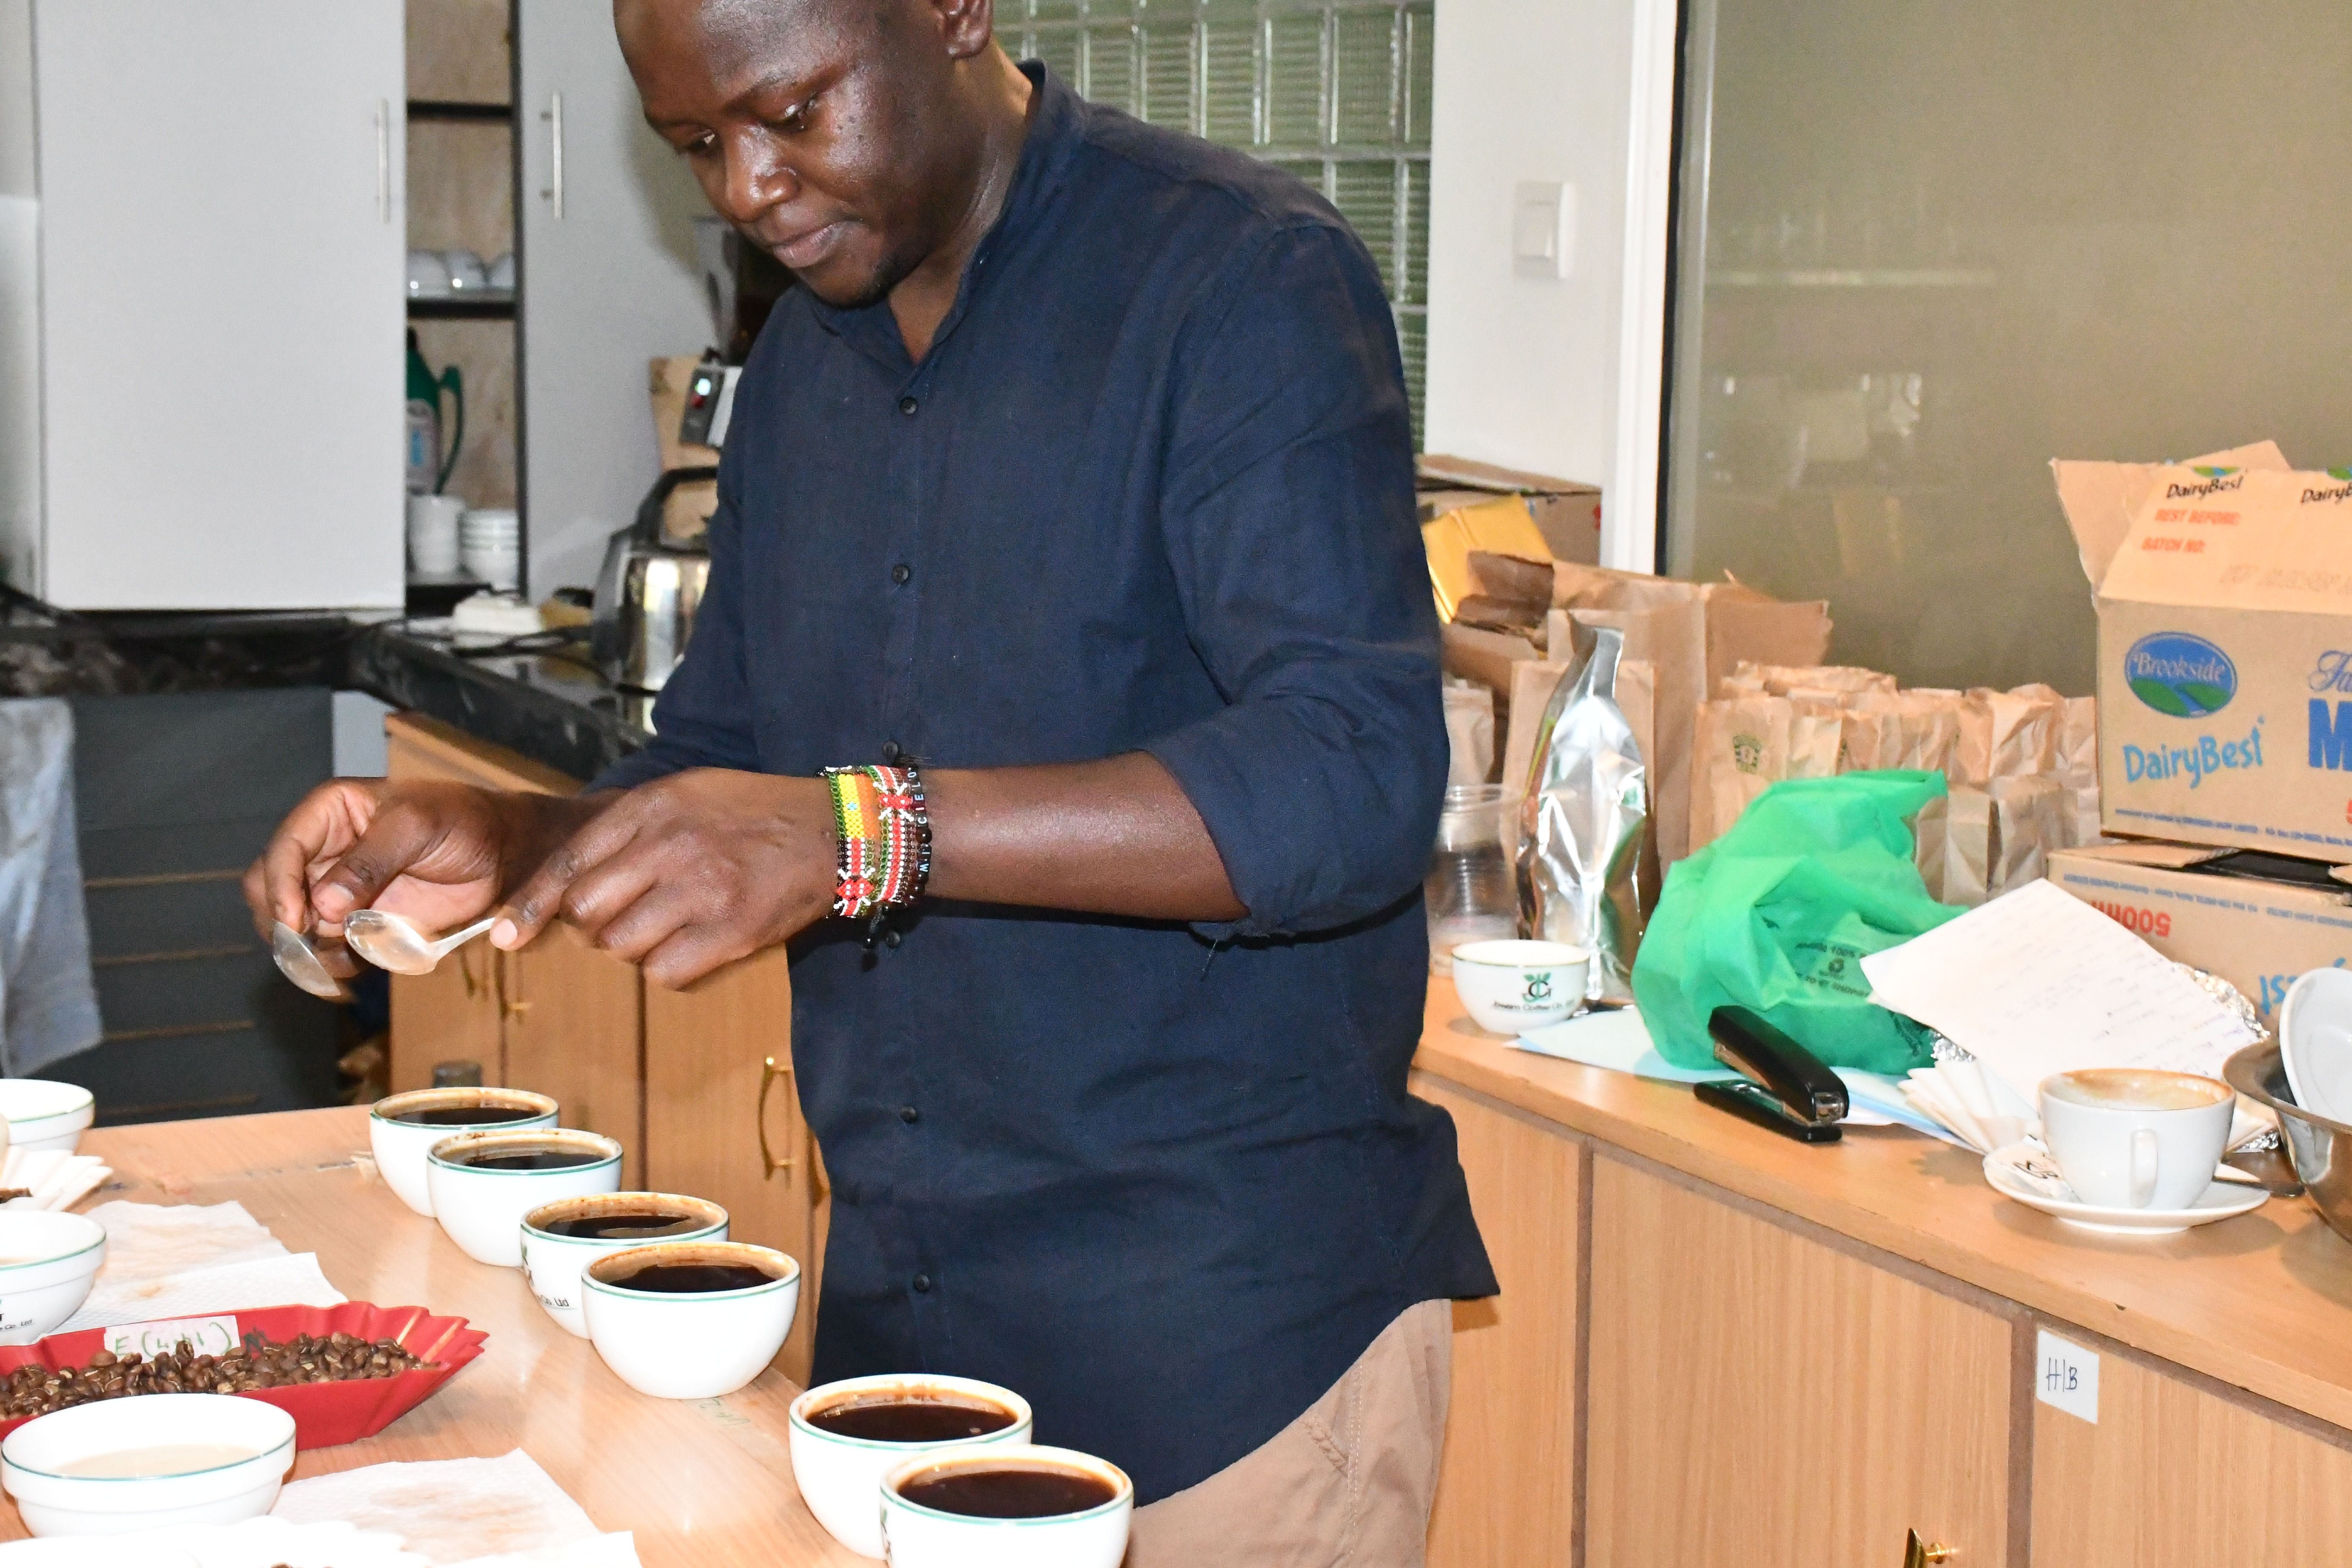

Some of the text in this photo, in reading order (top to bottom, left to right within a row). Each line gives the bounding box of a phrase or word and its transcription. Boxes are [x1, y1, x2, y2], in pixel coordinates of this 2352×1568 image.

[2167, 475, 2244, 500] DairyBest
[2155, 508, 2187, 522] BEST
[2141, 537, 2183, 551] BATCH
[2133, 653, 2225, 682] Brookside
[2123, 726, 2263, 789] DairyBest
[907, 772, 927, 824] CIELO
[554, 1297, 569, 1307] Ltd
